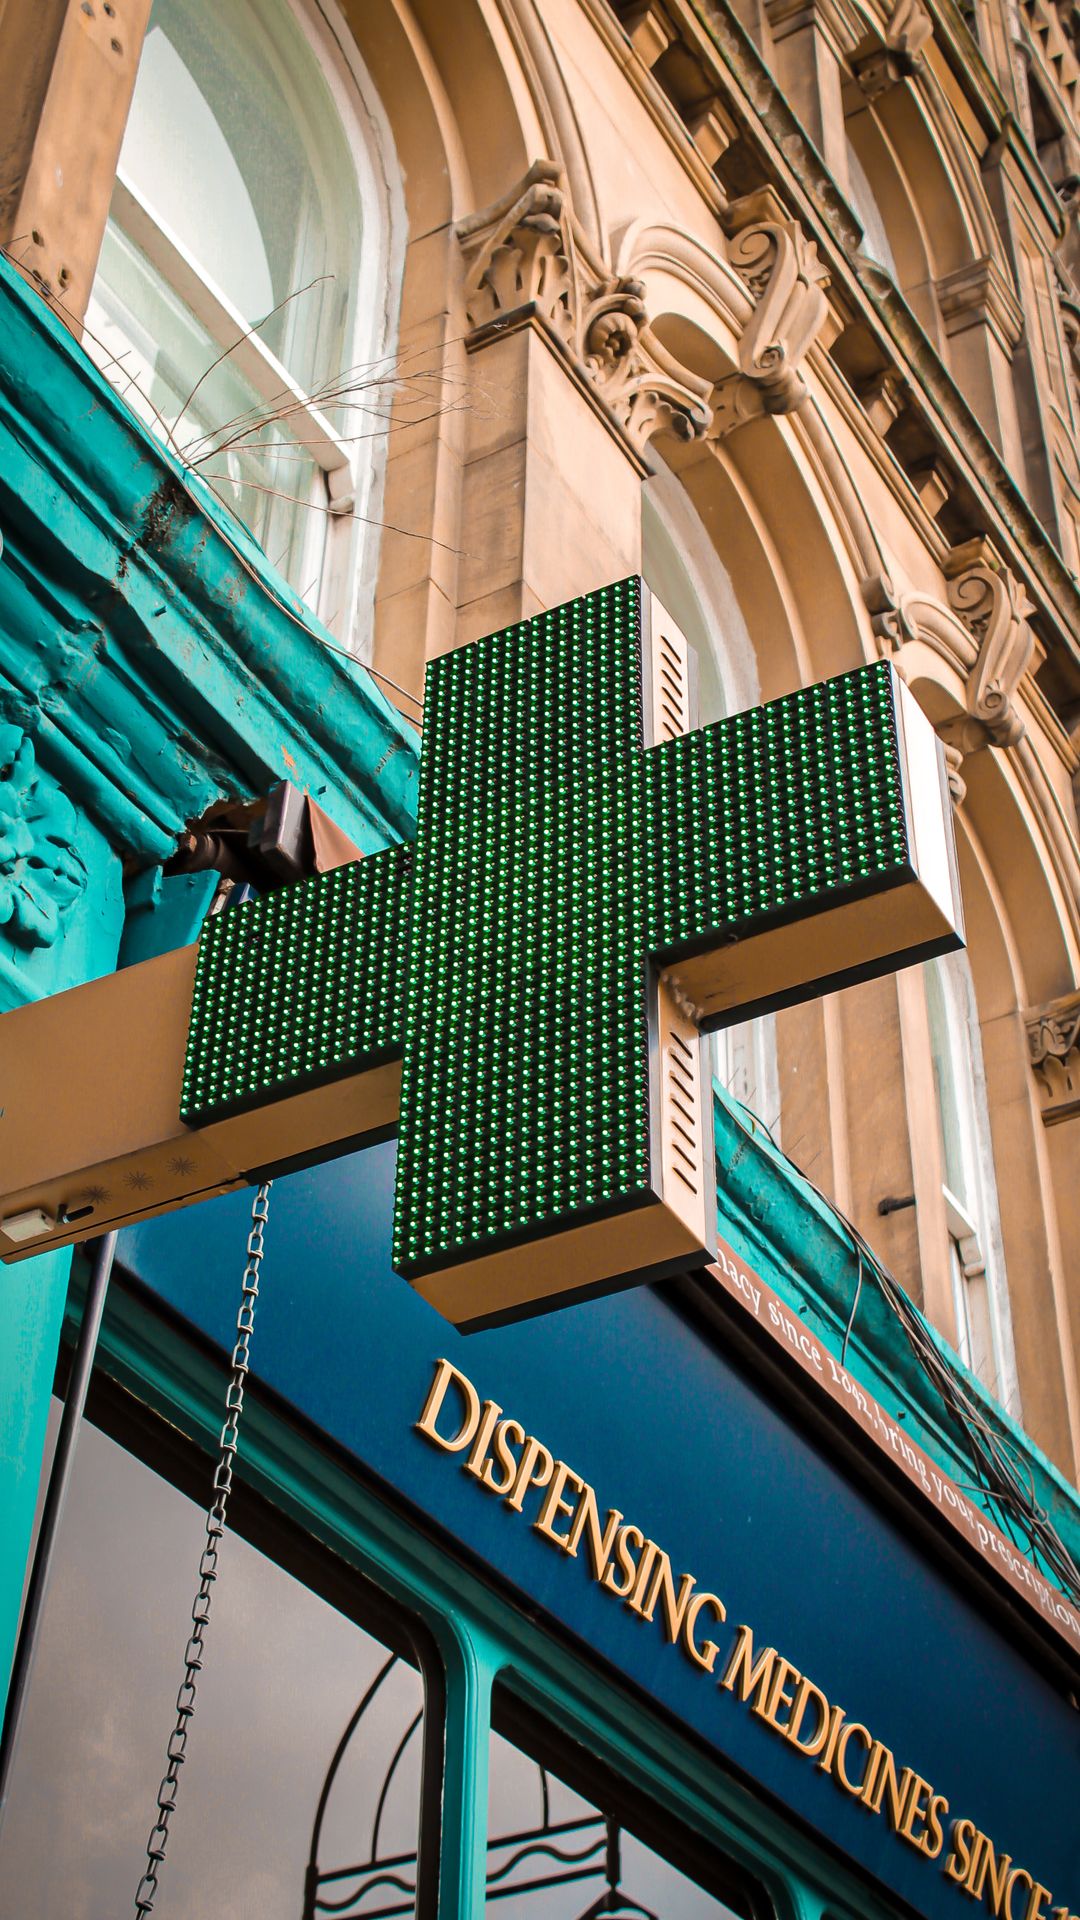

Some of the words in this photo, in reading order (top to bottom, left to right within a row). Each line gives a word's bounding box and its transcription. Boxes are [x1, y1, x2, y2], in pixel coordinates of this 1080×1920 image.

[768, 1300, 823, 1371] since
[874, 1402, 931, 1493] bring
[931, 1472, 975, 1529] your
[414, 1358, 727, 1673] DISPENSING
[721, 1625, 949, 1859] MEDICINES
